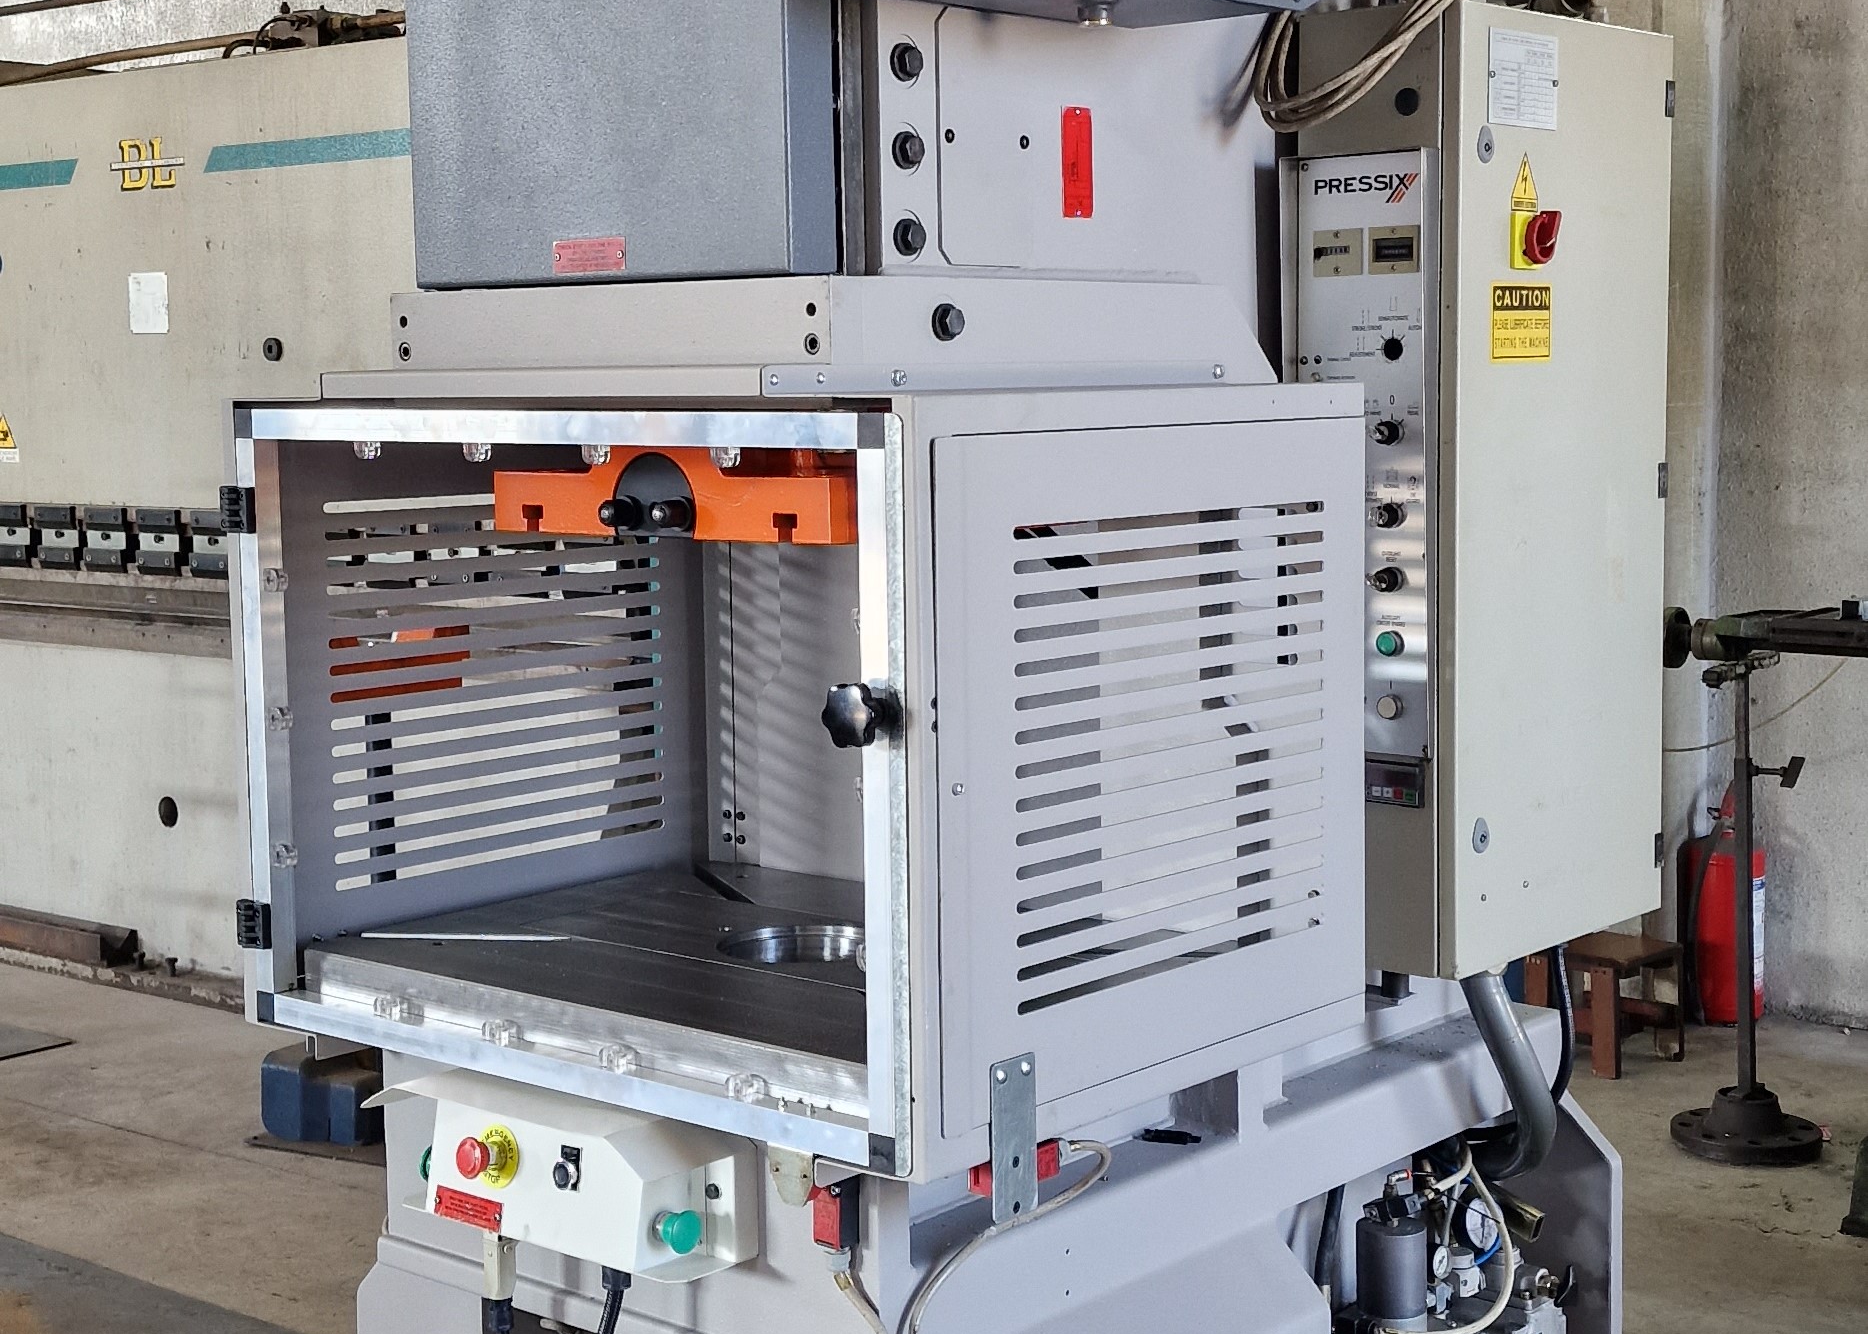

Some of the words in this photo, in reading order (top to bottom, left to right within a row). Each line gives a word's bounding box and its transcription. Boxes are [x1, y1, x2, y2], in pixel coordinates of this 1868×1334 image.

[119, 136, 176, 191] DL
[1313, 172, 1419, 203] PRESSIX
[1494, 289, 1549, 307] CAUTION
[1389, 394, 1395, 406] 0
